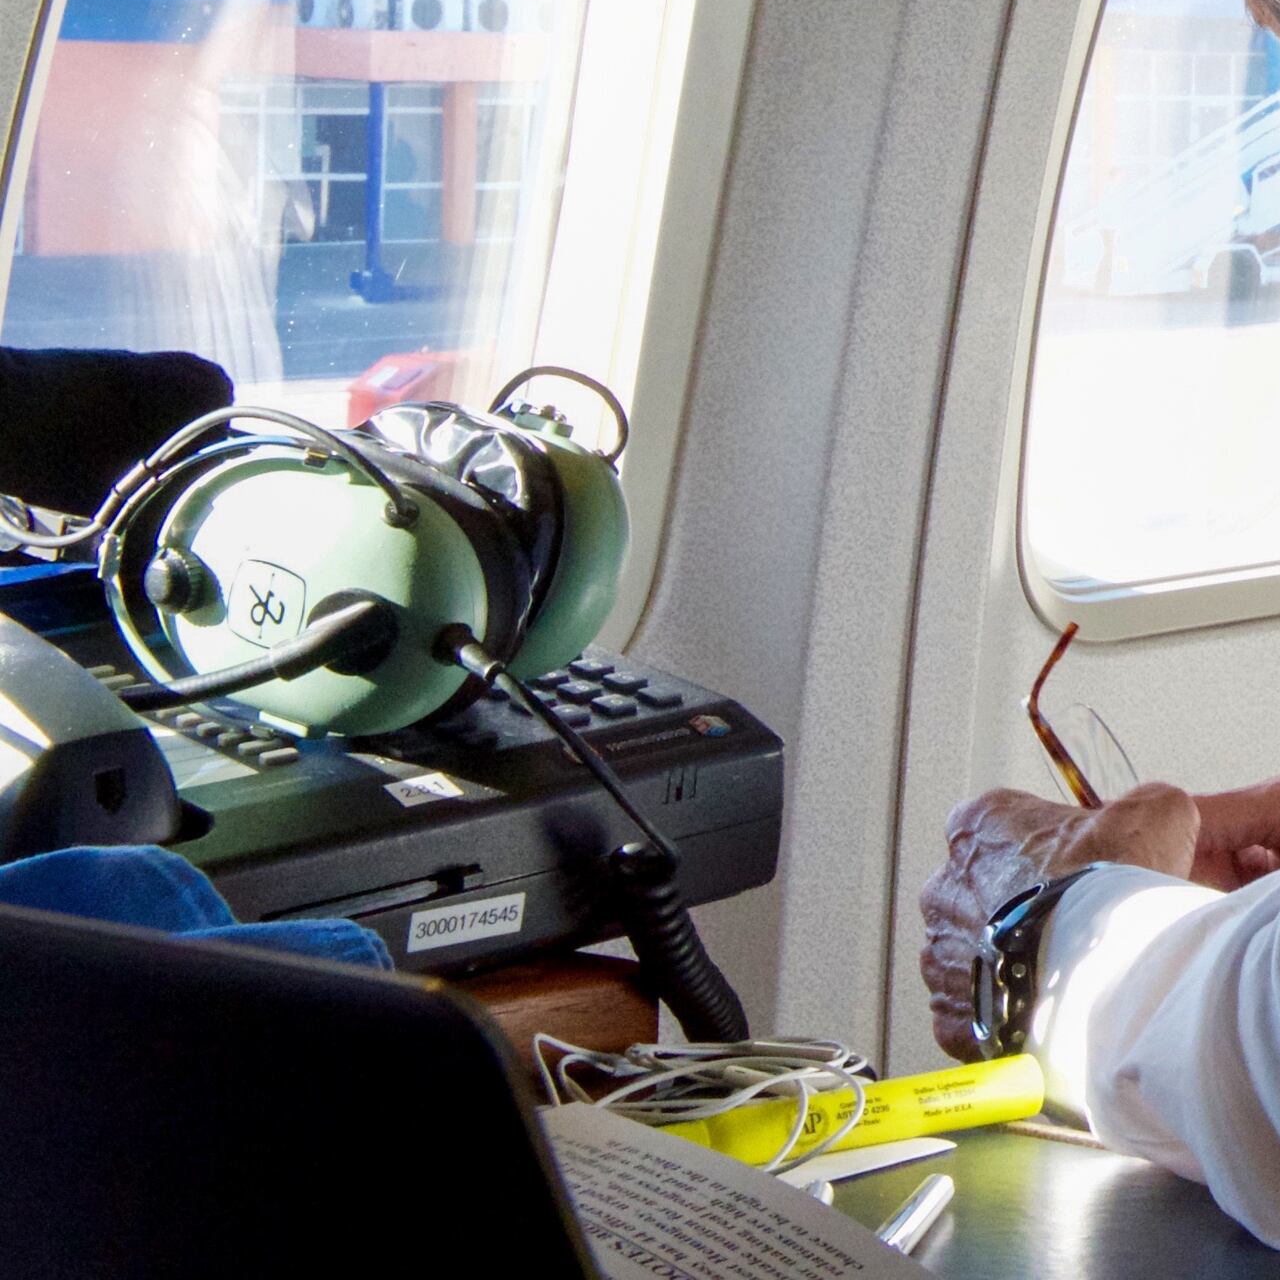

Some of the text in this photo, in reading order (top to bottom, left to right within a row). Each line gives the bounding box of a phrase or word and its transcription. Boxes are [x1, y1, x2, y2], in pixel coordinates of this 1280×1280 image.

[415, 904, 520, 940] 3000174545
[790, 1225, 808, 1236] to
[809, 1237, 864, 1270] chance
